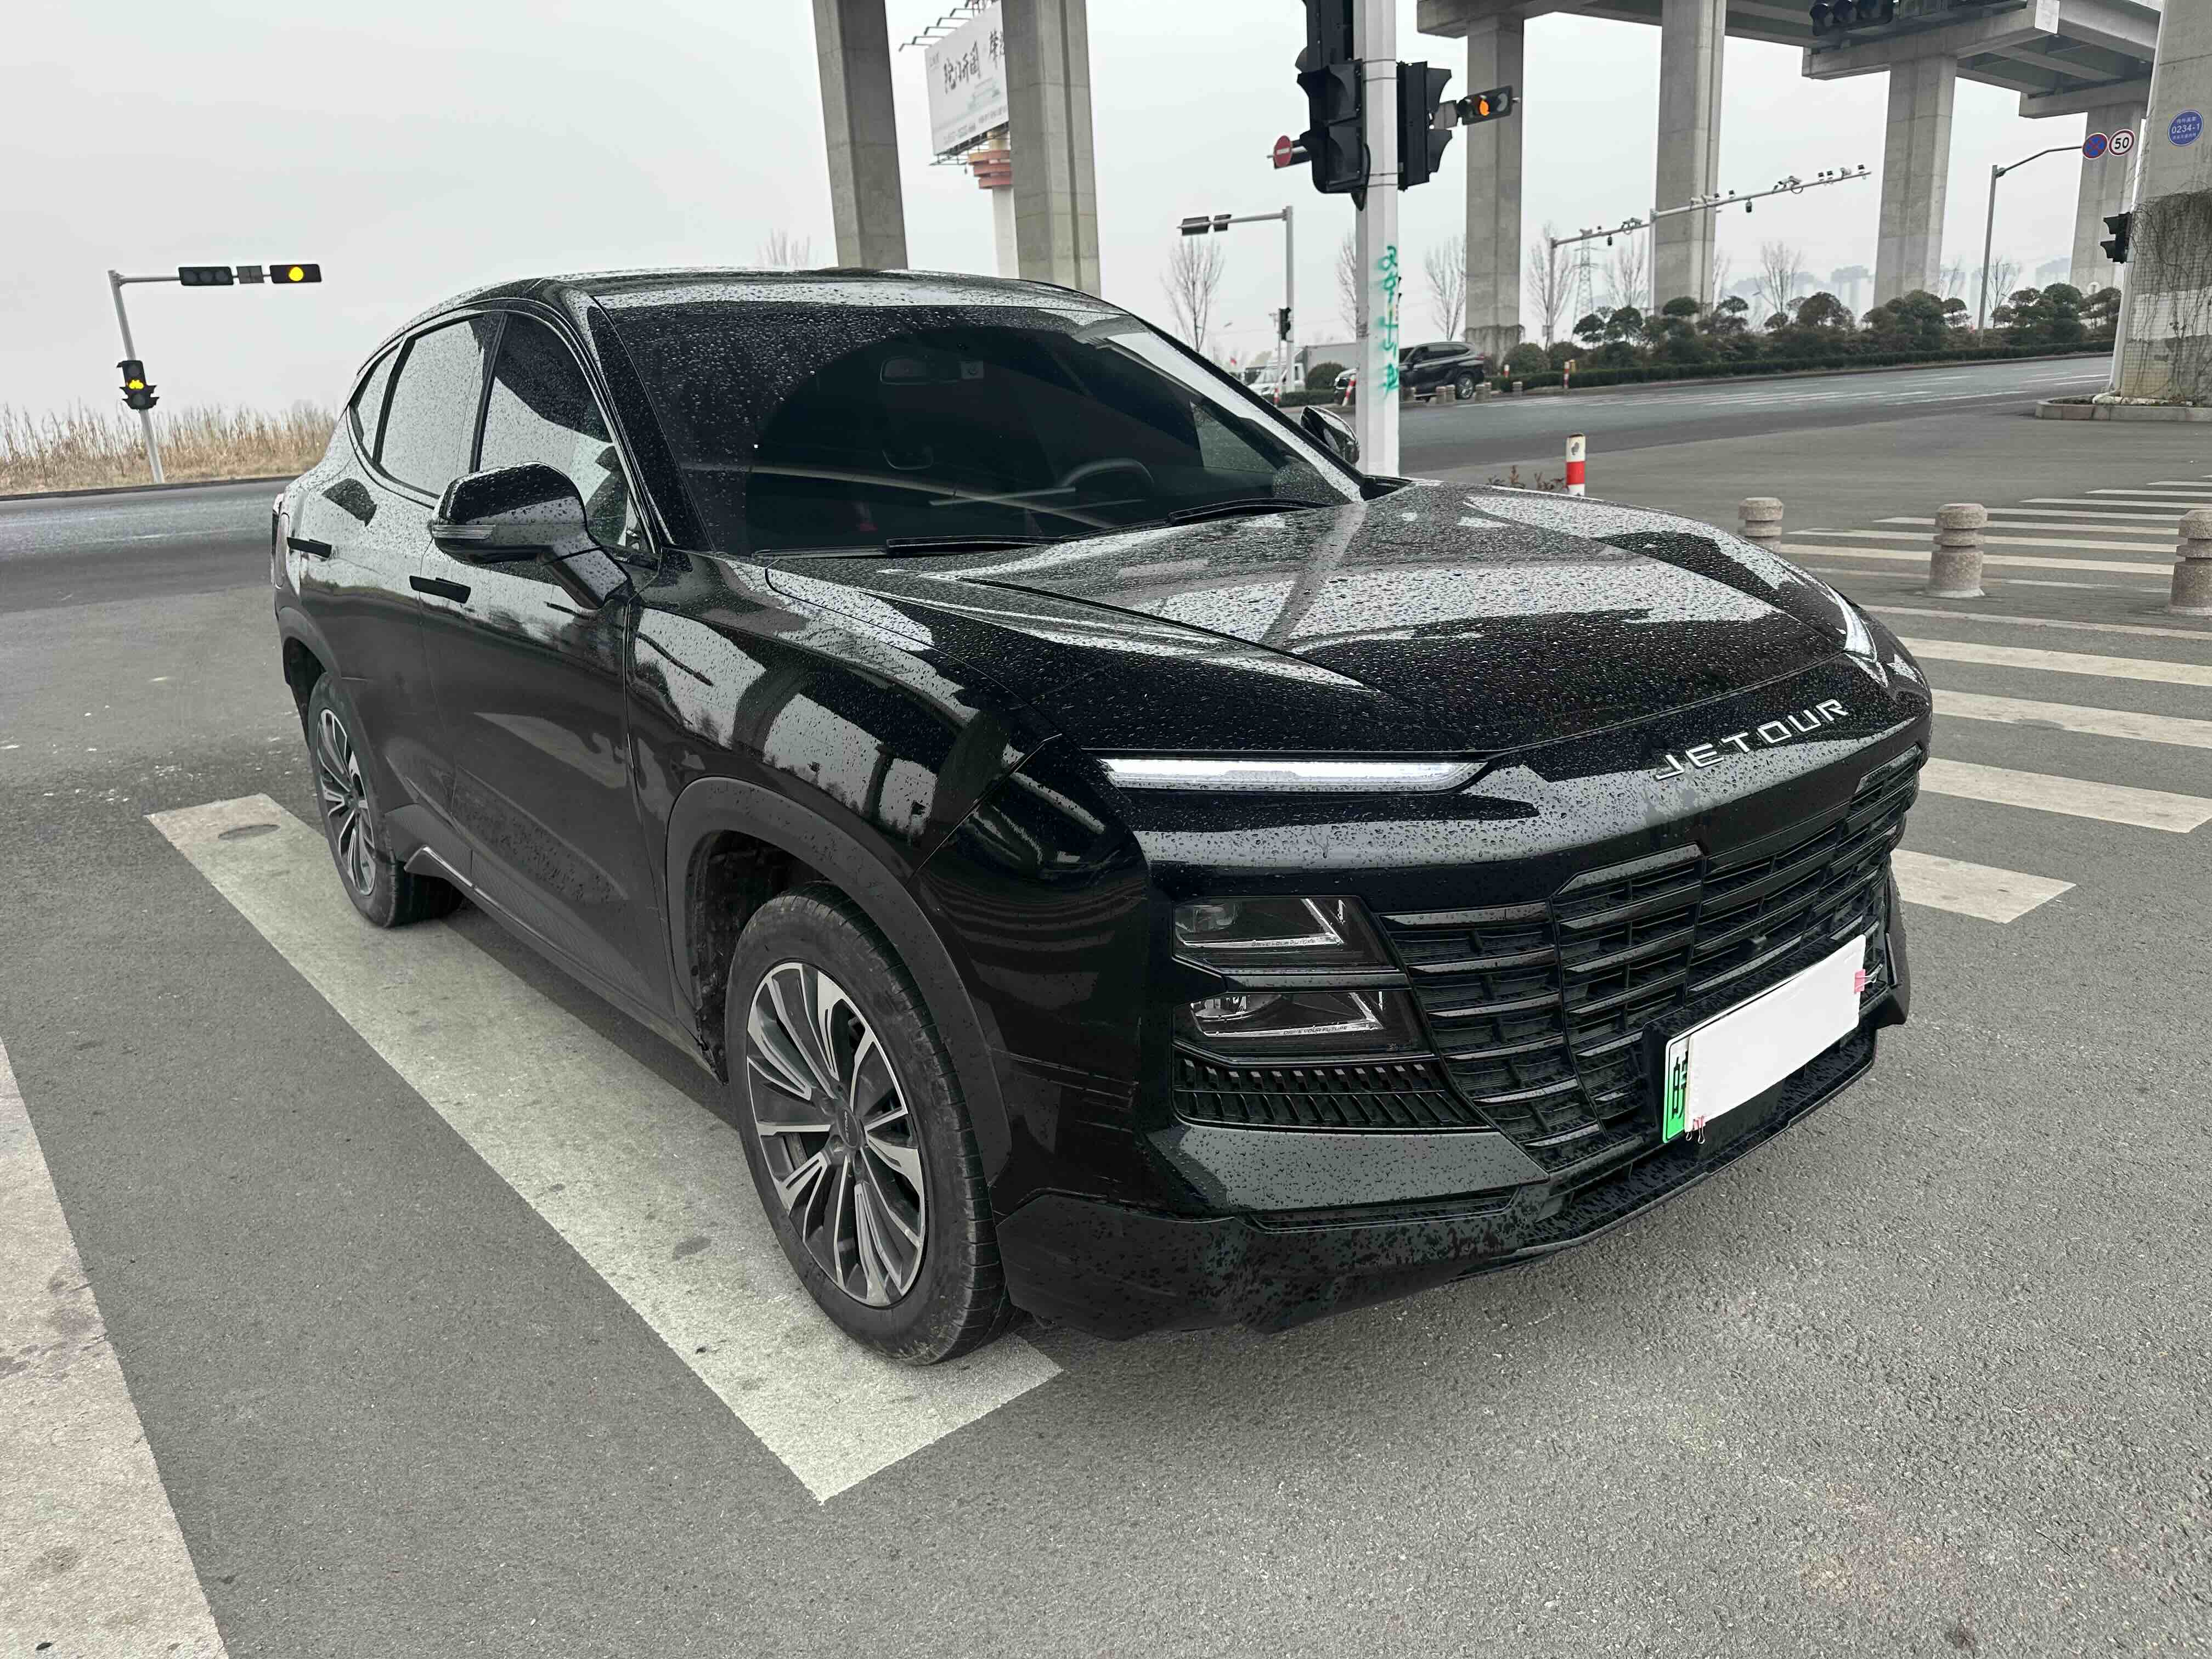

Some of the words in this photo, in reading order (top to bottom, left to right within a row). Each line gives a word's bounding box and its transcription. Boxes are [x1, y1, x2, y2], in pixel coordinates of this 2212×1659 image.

[2171, 122, 2200, 134] 0234-1
[2114, 137, 2129, 150] 50
[1655, 698, 1849, 781] JETOUR
